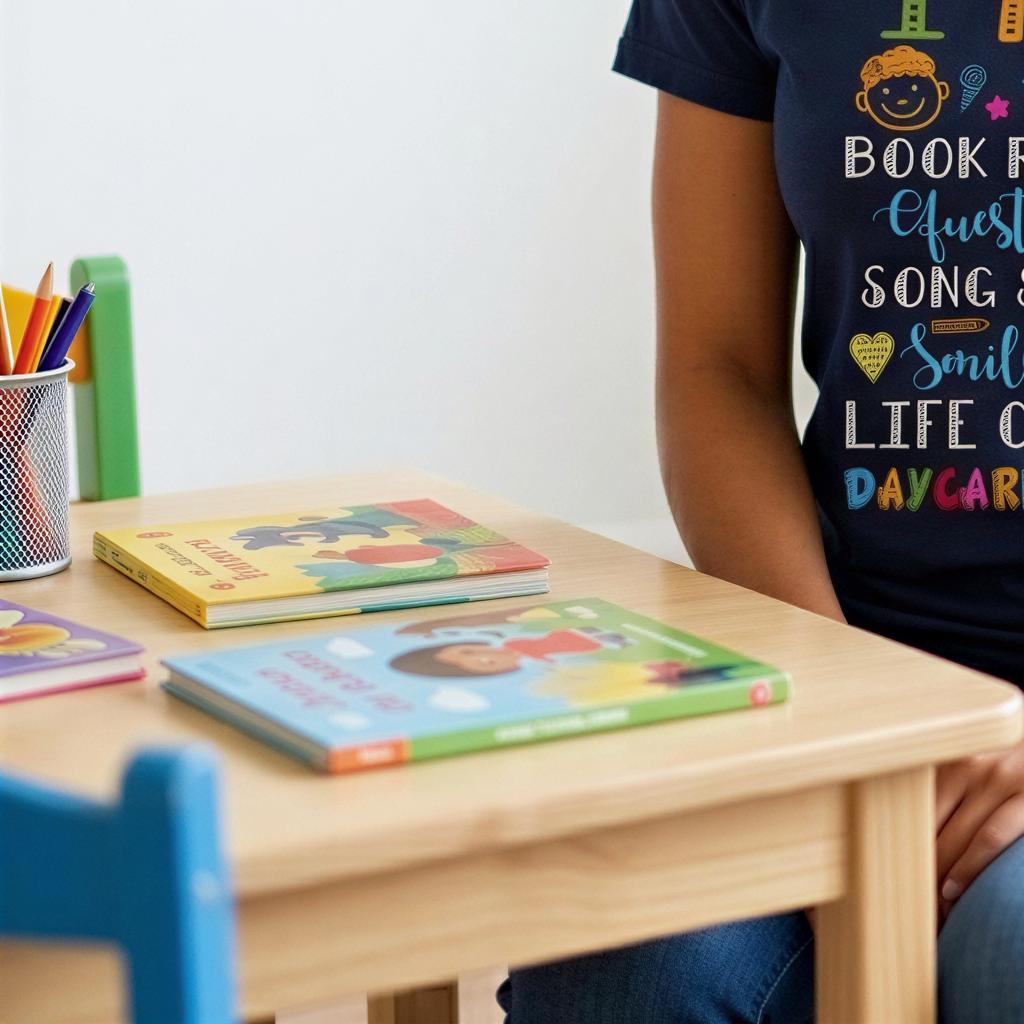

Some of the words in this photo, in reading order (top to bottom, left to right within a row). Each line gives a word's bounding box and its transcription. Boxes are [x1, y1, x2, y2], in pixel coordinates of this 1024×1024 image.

[845, 136, 987, 178] BOOK
[861, 265, 995, 308] SONG
[845, 399, 976, 449] LIFE
